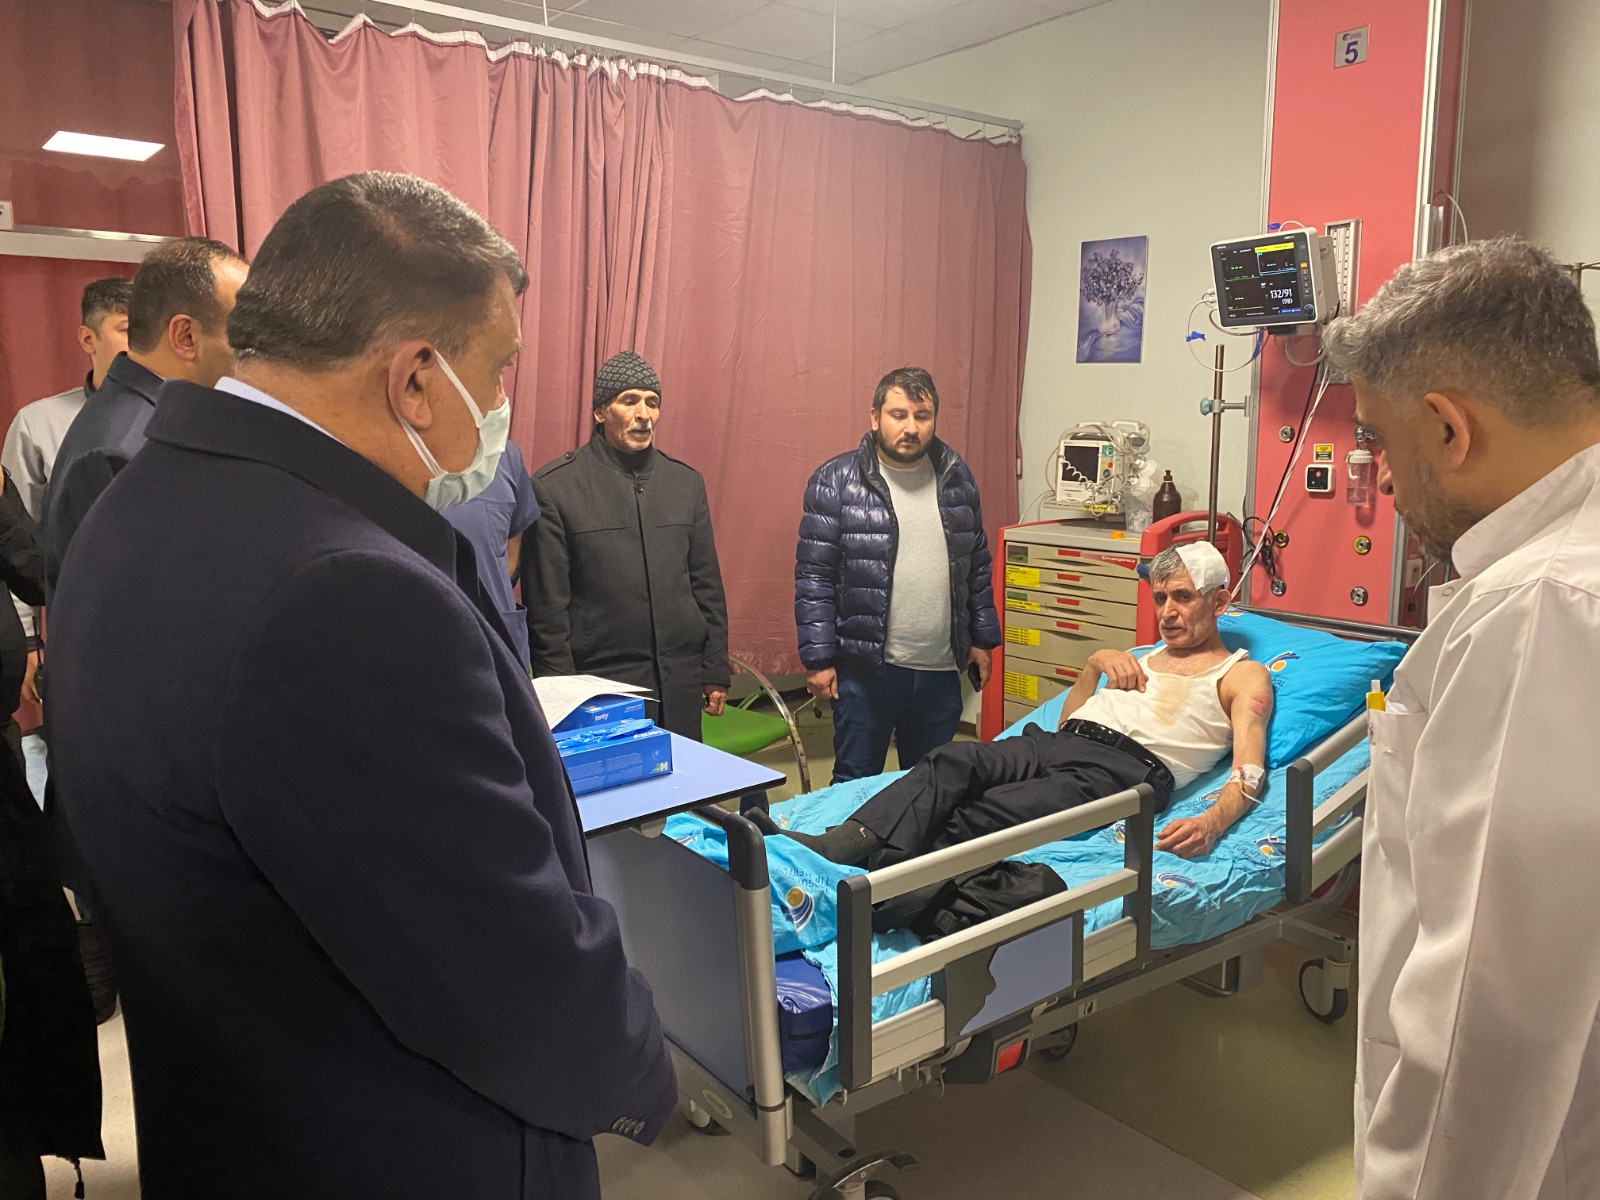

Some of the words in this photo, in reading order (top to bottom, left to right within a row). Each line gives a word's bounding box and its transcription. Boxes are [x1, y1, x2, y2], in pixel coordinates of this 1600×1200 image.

[1344, 40, 1359, 64] 5
[1270, 288, 1292, 298] 132/91
[1101, 555, 1136, 564] Emergency
